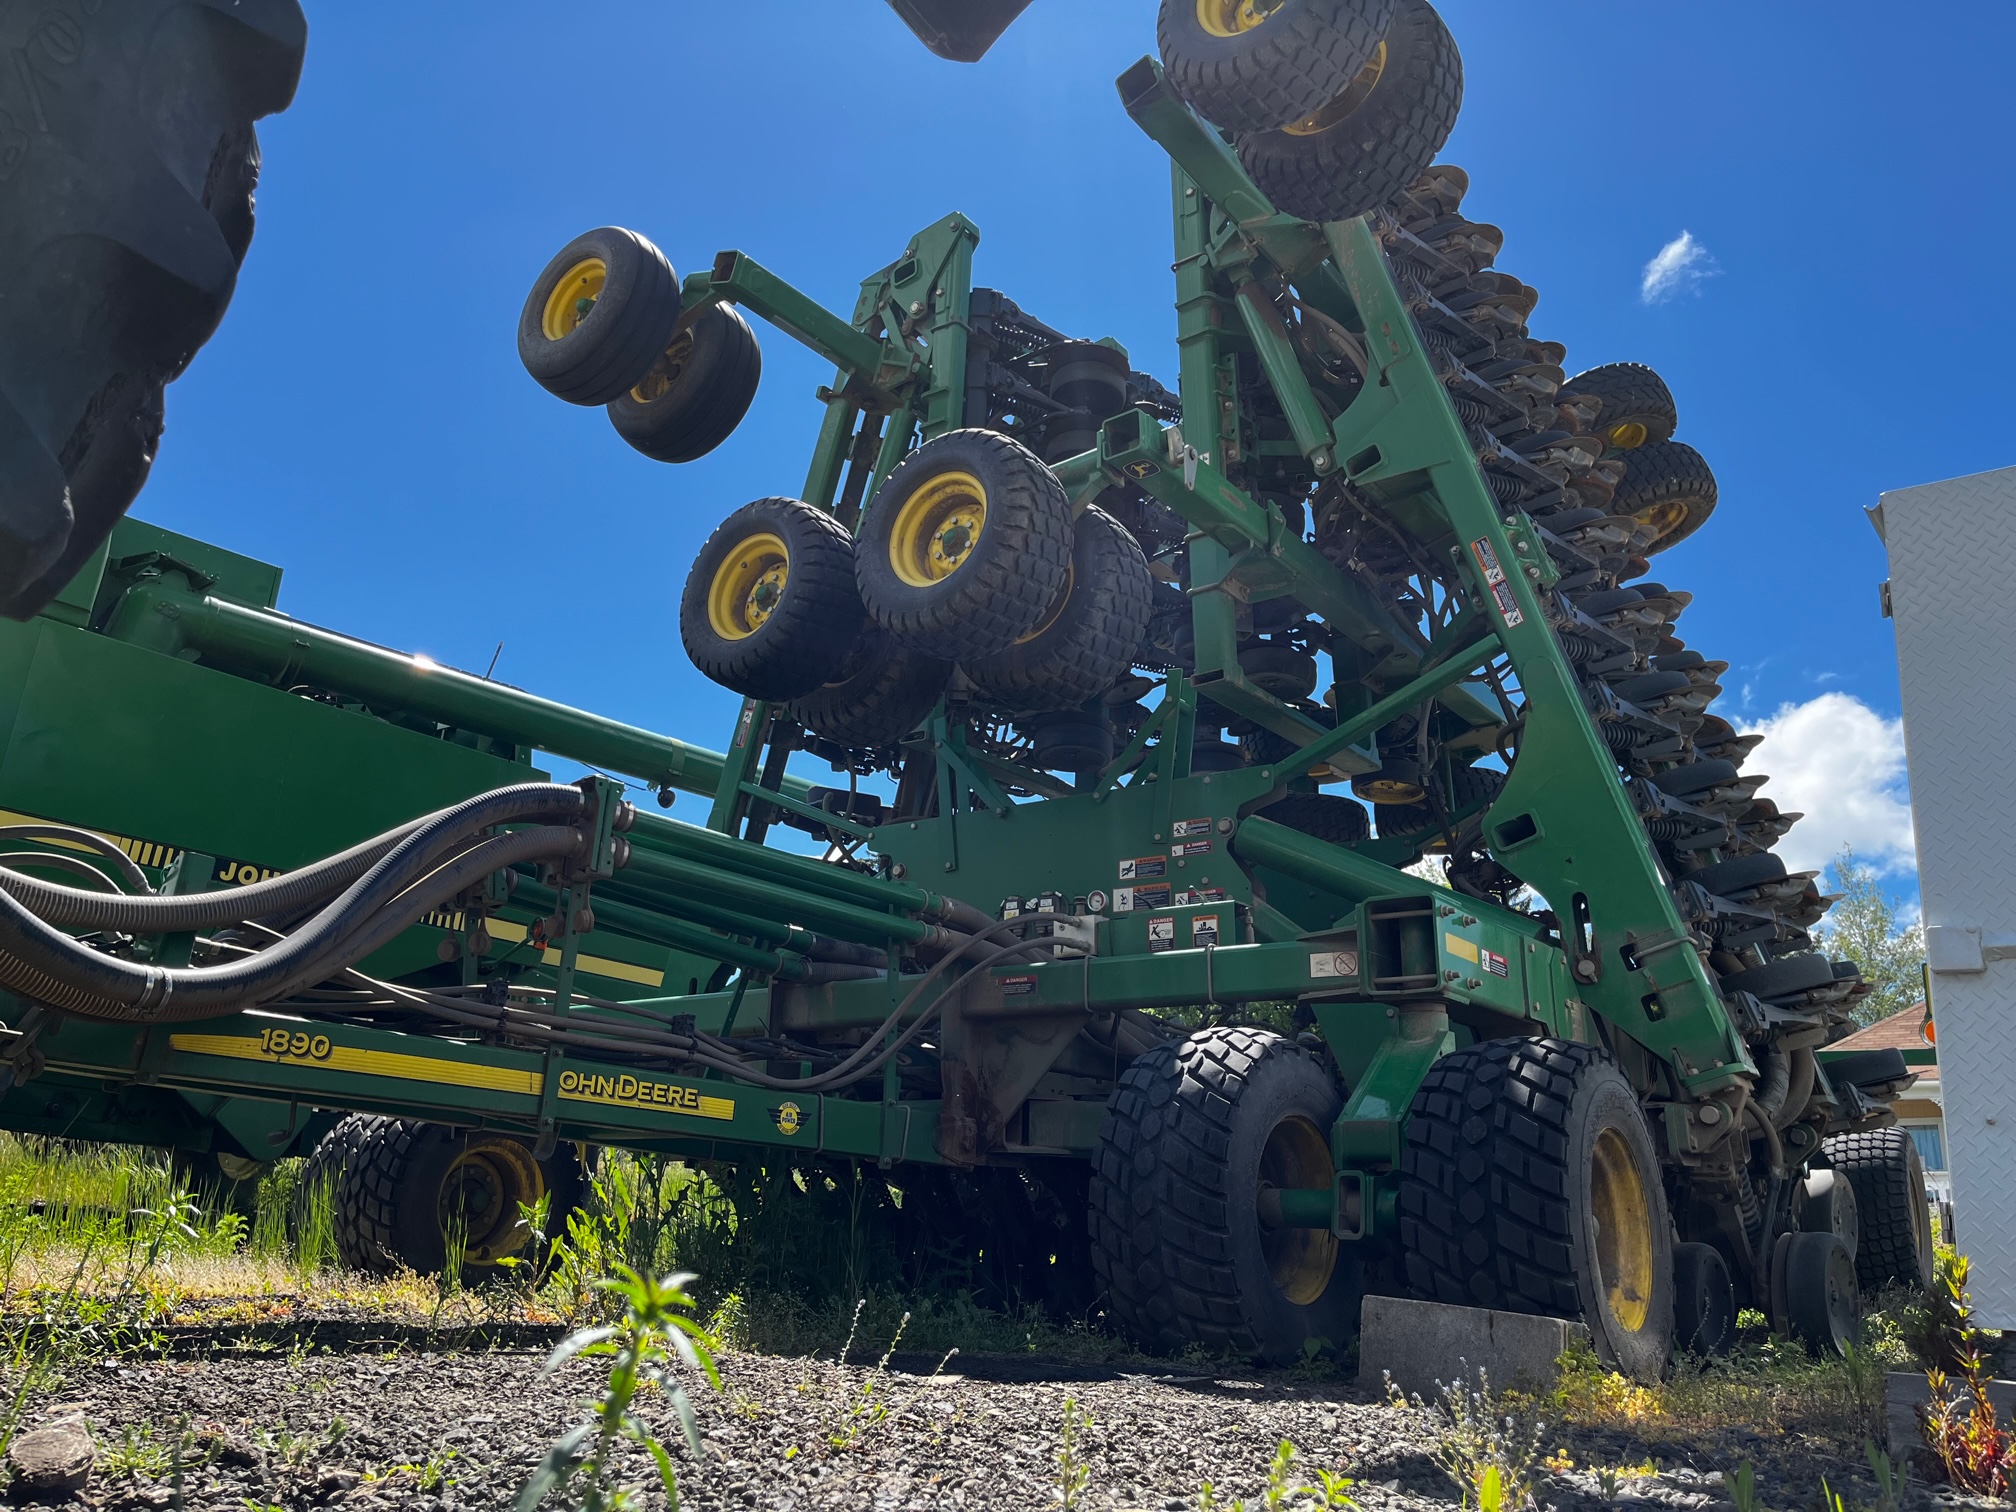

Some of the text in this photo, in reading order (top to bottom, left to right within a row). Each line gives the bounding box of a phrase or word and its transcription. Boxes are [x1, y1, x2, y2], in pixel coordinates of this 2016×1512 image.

[219, 862, 281, 886] JOH
[261, 1028, 331, 1060] 1890
[559, 1071, 699, 1107] OHN DEERE
